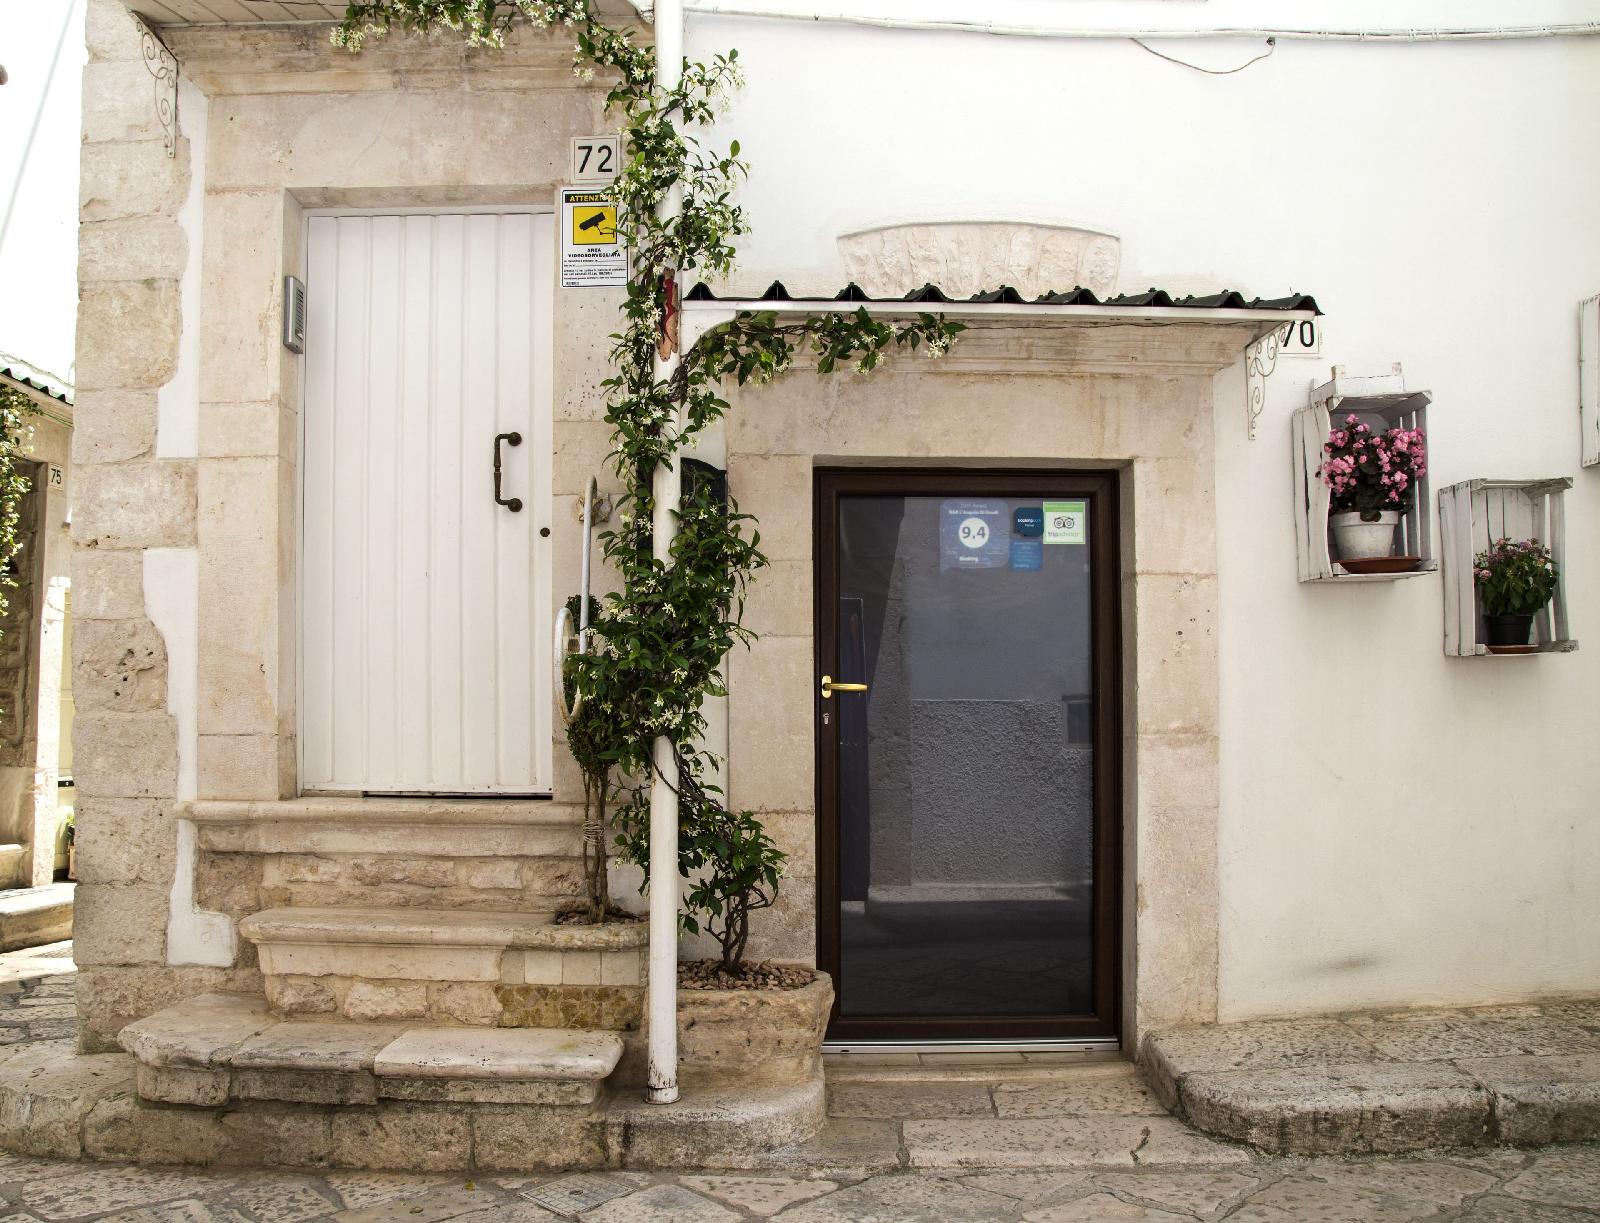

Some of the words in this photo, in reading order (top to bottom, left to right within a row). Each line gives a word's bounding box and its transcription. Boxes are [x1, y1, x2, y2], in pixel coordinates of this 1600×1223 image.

[578, 145, 612, 173] 72
[570, 194, 617, 202] ATTENZIN
[50, 467, 62, 484] 75
[962, 526, 986, 539] 9.4
